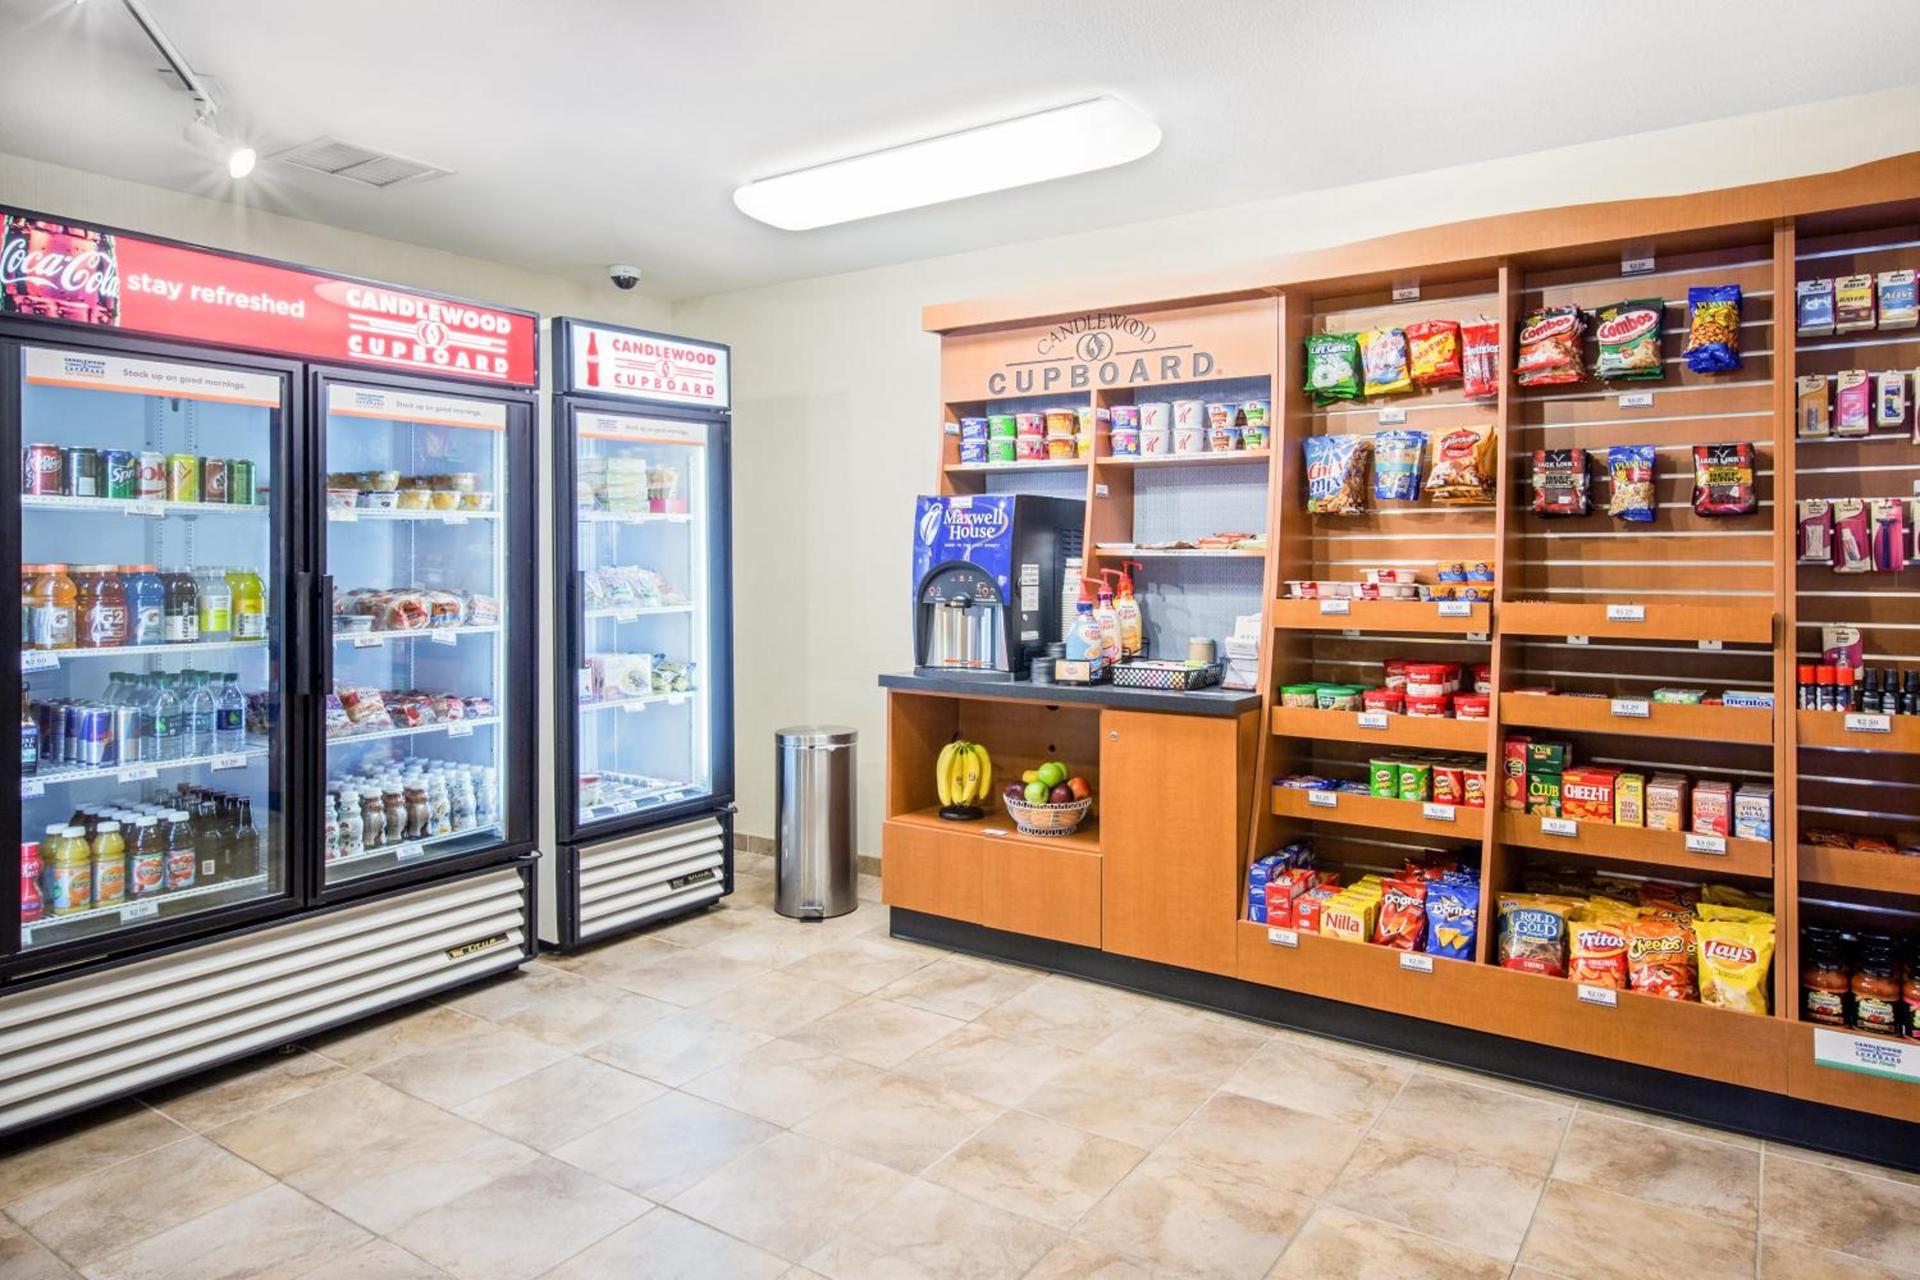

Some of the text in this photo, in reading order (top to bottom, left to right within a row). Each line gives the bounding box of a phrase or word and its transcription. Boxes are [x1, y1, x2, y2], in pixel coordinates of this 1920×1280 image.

[0, 238, 119, 298] Coca-Cola
[127, 272, 305, 319] stay refreshed
[345, 288, 512, 334] CANDLEWOOD
[1037, 311, 1157, 356] CANDLEWOOD
[1521, 316, 1573, 342] Combos
[1600, 312, 1655, 339] Combos
[347, 334, 509, 373] CUPBOARD
[612, 339, 716, 366] CANDLEWOOD
[123, 368, 149, 379] Stock
[150, 373, 164, 382] up
[165, 374, 178, 382] on
[180, 376, 203, 387] good
[614, 373, 715, 396] CUPBOARD
[988, 351, 1214, 395] CUPBOARD
[943, 507, 1003, 525] Maxwell
[949, 525, 996, 540] House
[1726, 696, 1772, 707] mentos
[1530, 782, 1559, 796] CLUB
[1564, 784, 1611, 802] CHEEZ-IT
[1432, 902, 1476, 918] Doritos
[1520, 911, 1556, 925] ROLD
[1325, 912, 1360, 933] Nilla
[1515, 921, 1557, 937] GOLD
[1629, 936, 1682, 960] Cheetos
